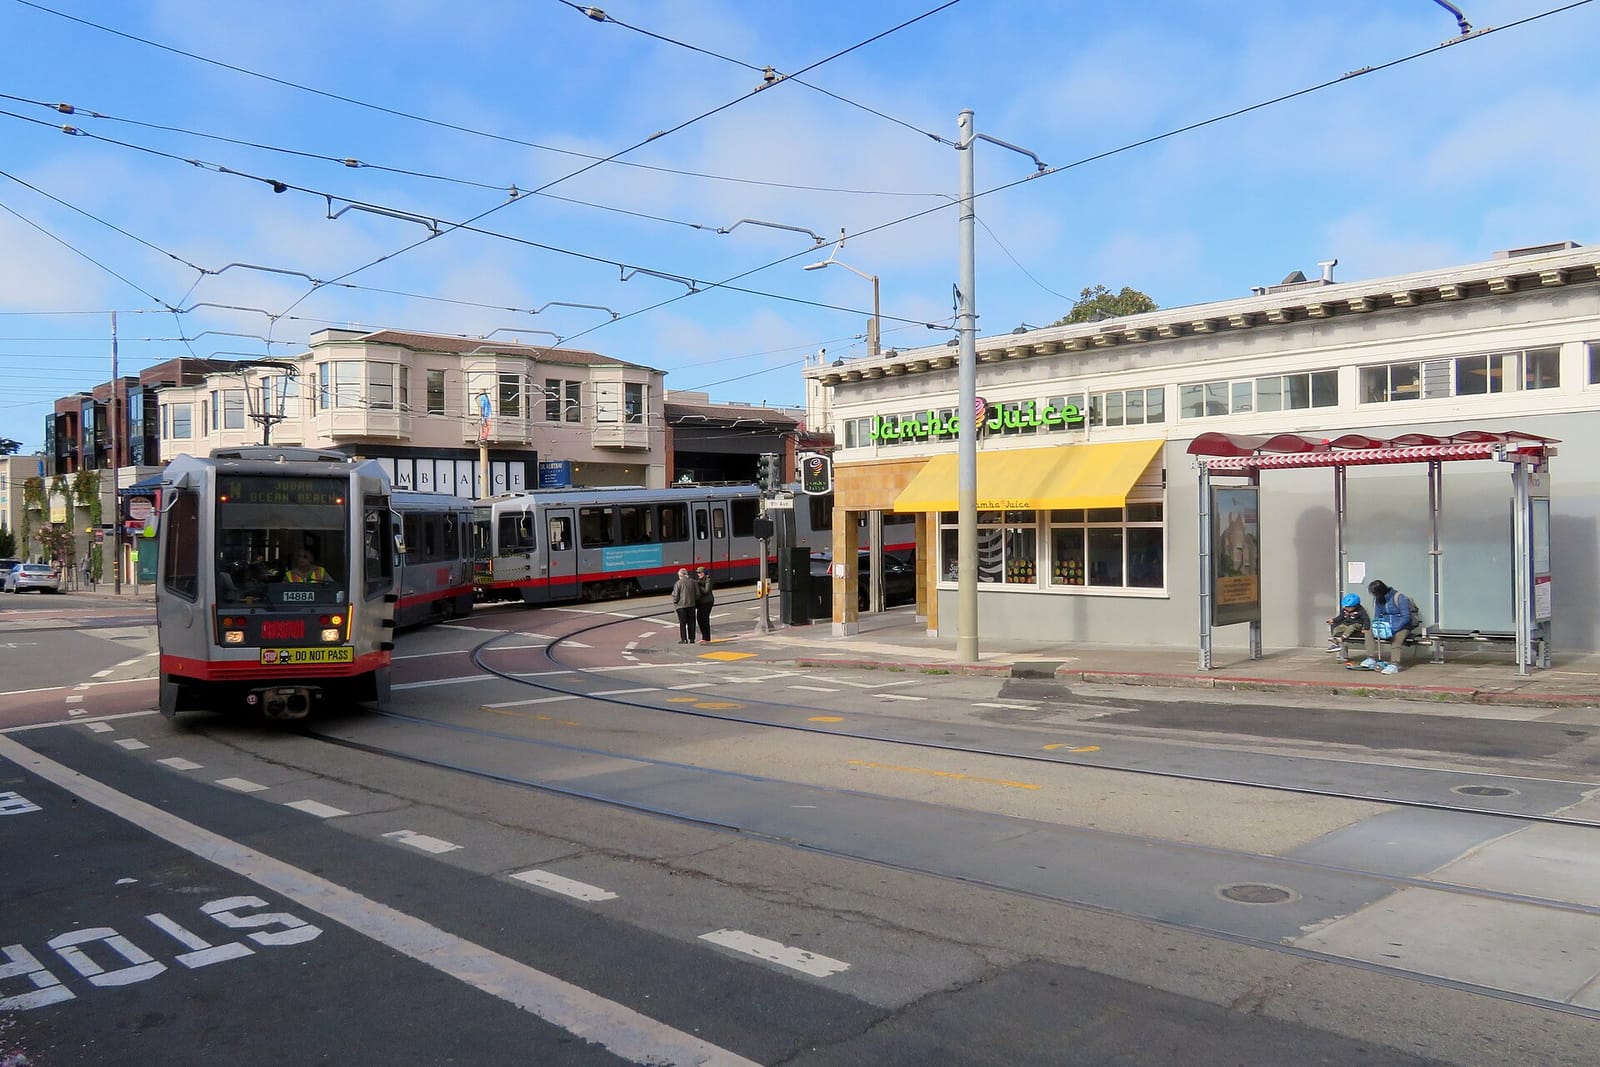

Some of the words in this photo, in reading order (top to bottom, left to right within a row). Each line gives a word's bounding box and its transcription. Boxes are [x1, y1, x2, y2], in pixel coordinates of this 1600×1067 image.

[988, 400, 1084, 430] Juice
[274, 480, 313, 490] JUDAH
[249, 492, 290, 502] OCEAN
[1005, 499, 1031, 509] Juice
[284, 591, 315, 602] 1488A
[295, 650, 307, 661] DO
[309, 650, 326, 661] NOT
[327, 649, 349, 661] PASS
[0, 895, 323, 1011] STOP
